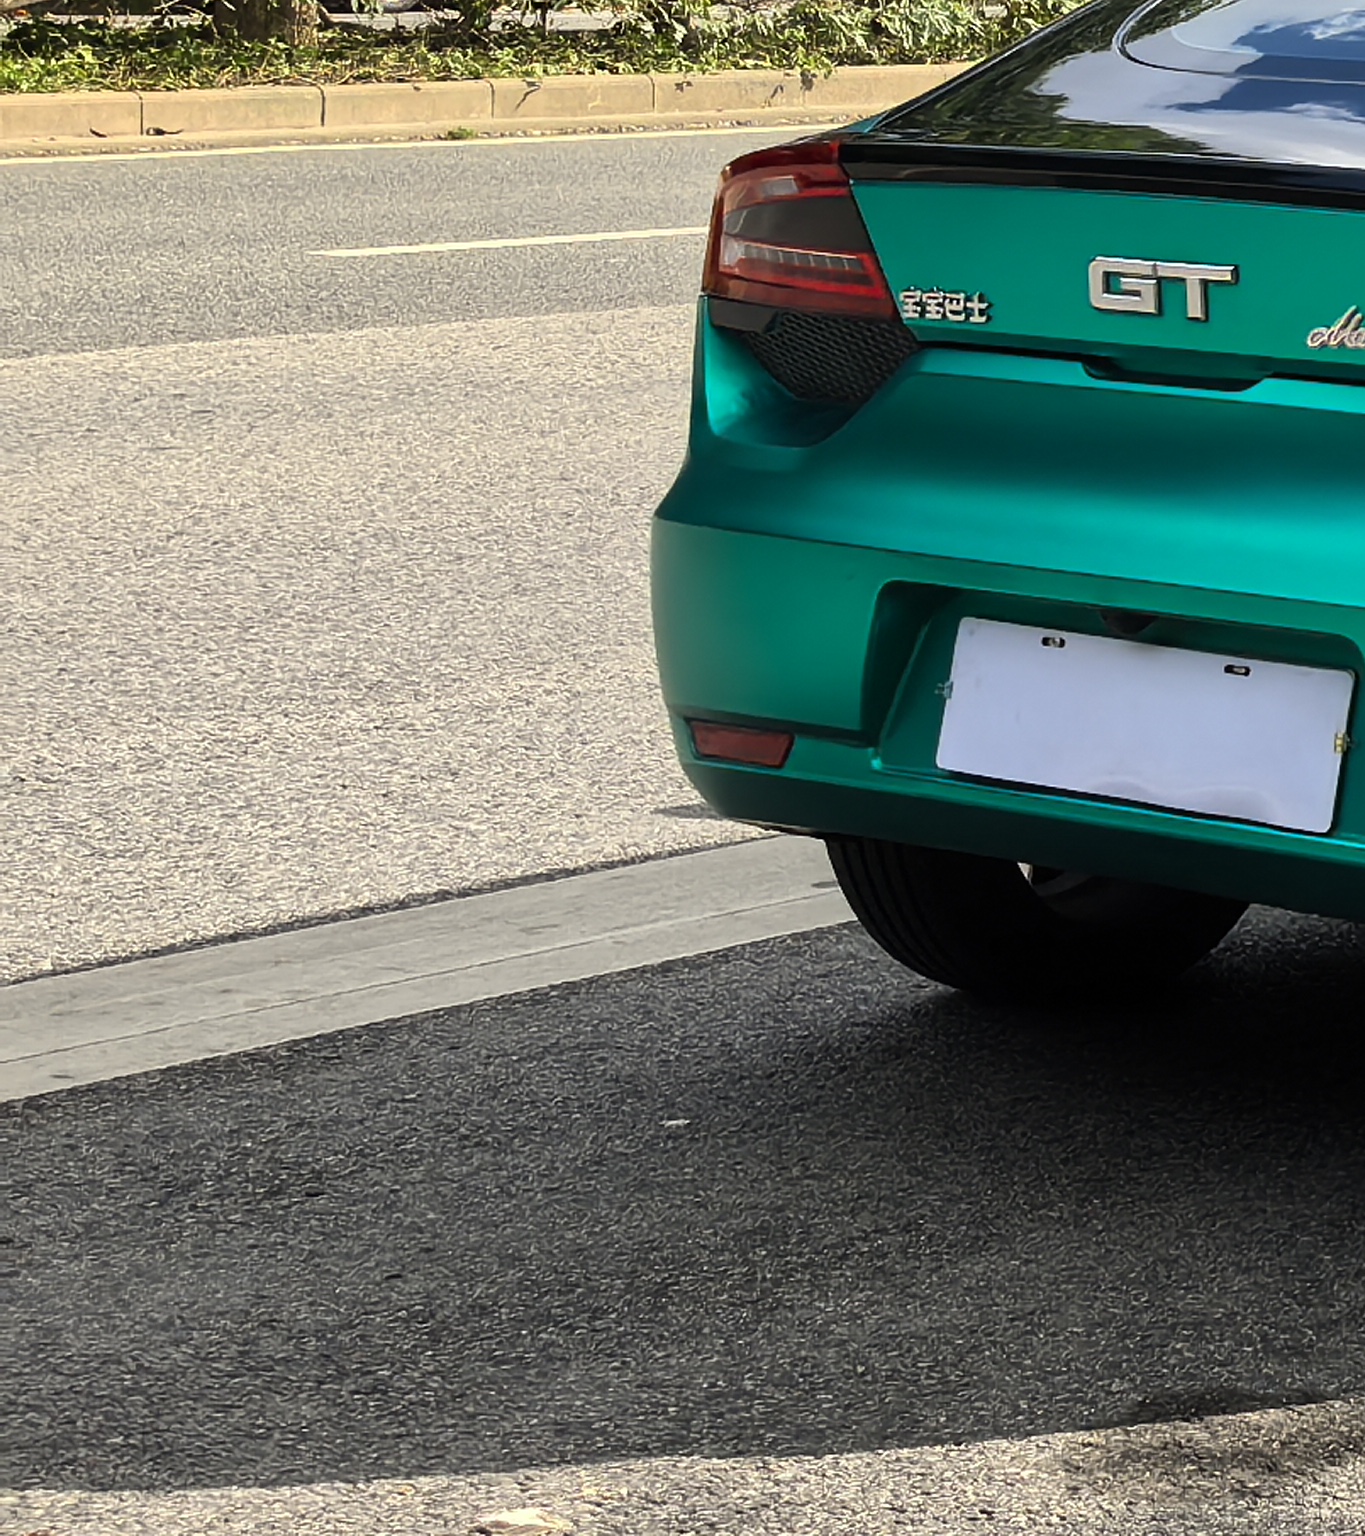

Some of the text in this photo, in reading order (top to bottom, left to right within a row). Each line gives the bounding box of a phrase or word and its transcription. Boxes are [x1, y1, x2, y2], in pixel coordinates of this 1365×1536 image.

[900, 286, 990, 324] 宝宝巴士
[1088, 255, 1239, 322] GT
